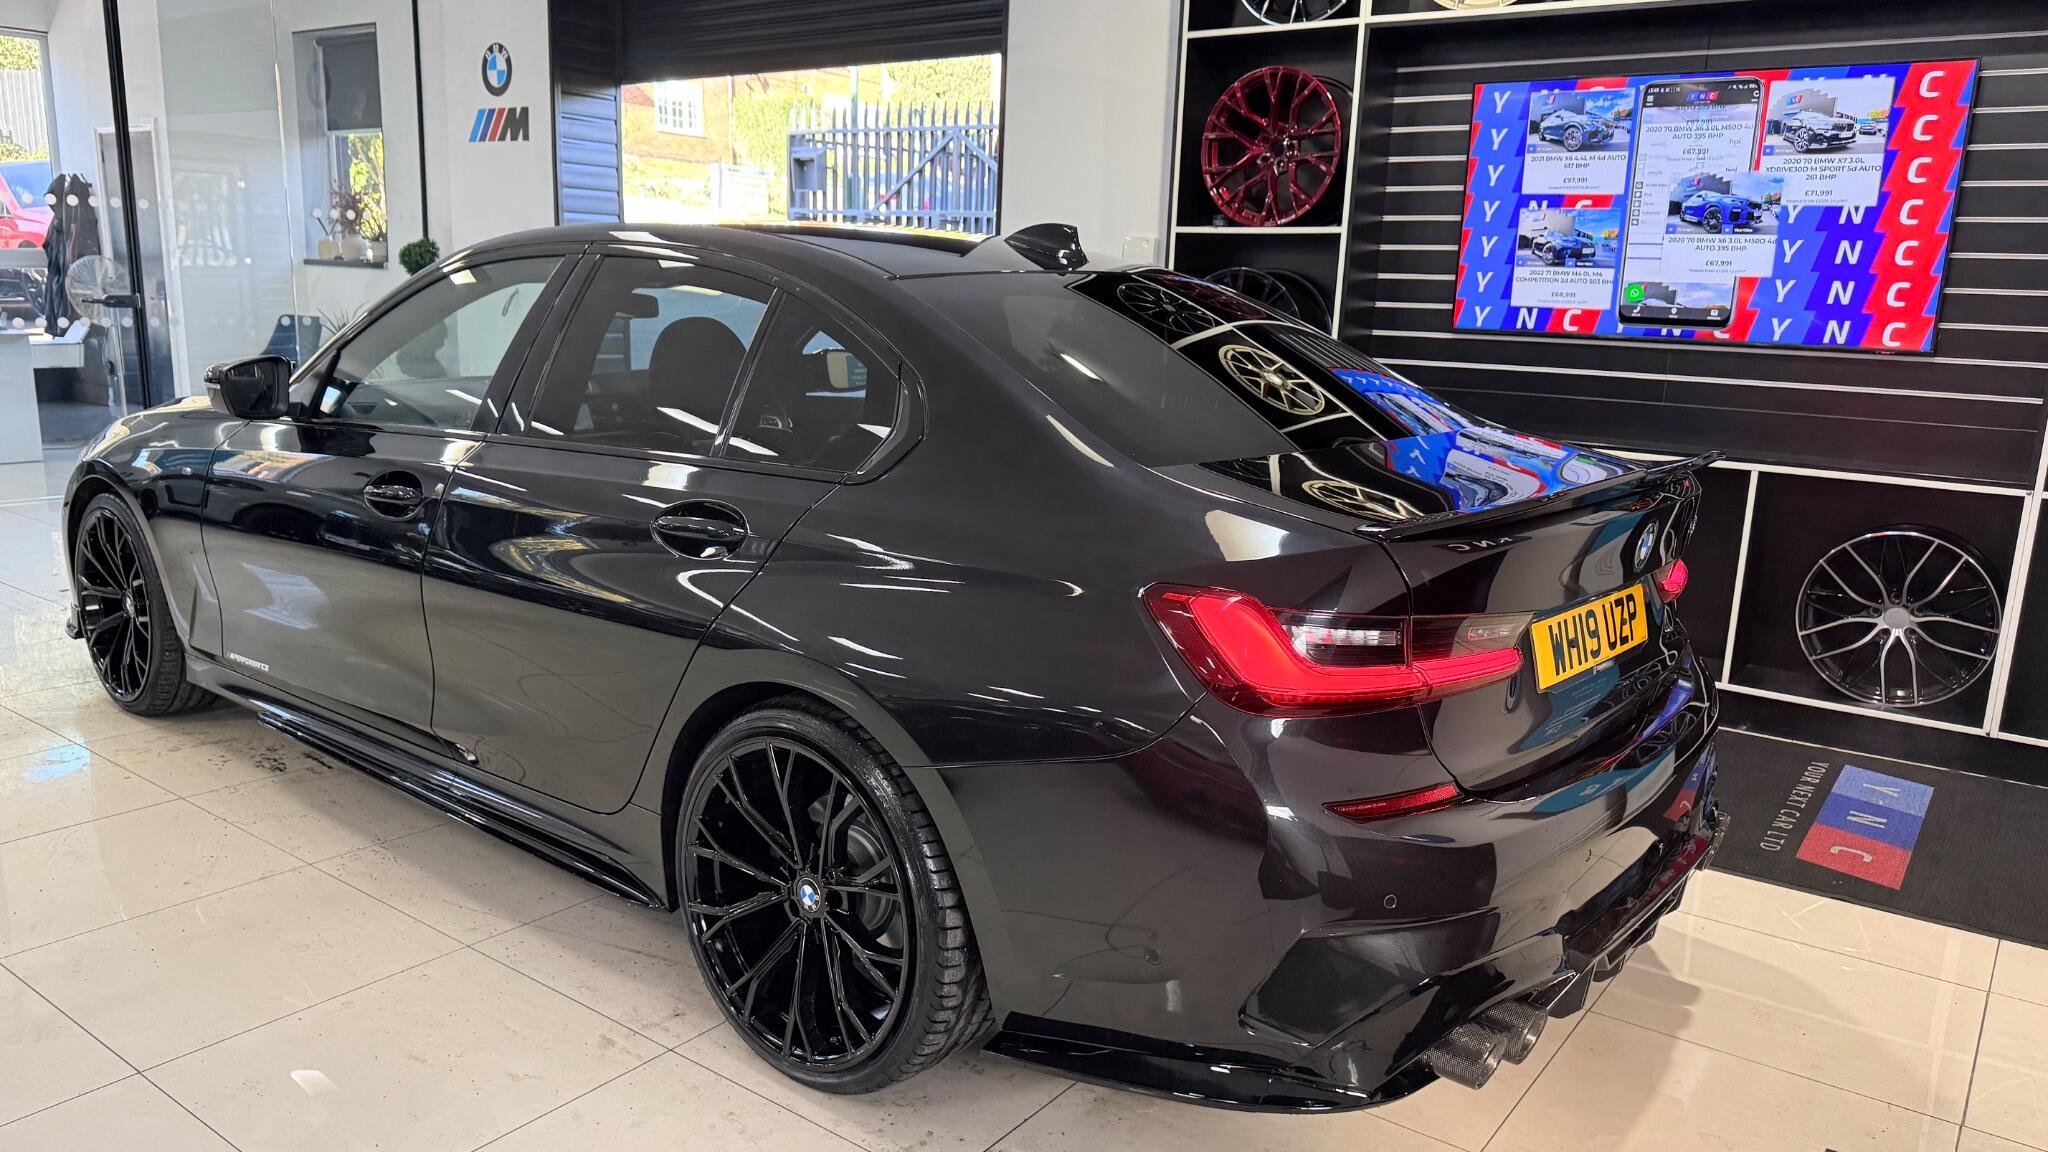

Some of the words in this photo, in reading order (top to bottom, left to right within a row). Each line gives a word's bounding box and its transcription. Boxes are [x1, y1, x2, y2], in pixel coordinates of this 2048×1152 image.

[1920, 70, 1946, 98] C
[1494, 90, 1512, 114] Y
[1490, 128, 1508, 151] Y
[1912, 114, 1938, 142] C
[1488, 164, 1505, 187] Y
[1908, 156, 1933, 184] C
[1484, 200, 1500, 223] Y
[1899, 199, 1923, 225] C
[1481, 235, 1499, 258] Y
[1783, 240, 1804, 263] Y
[1834, 240, 1863, 265] N
[1894, 240, 1919, 266] C
[1477, 271, 1494, 293] Y
[1775, 279, 1796, 303] Y
[1826, 281, 1855, 305] N
[1886, 282, 1911, 307] C
[1474, 306, 1492, 327] Y
[1516, 307, 1538, 329] N
[1563, 308, 1582, 332] C
[1771, 318, 1793, 341] Y
[1823, 320, 1851, 344] N
[1882, 322, 1907, 347] C
[1548, 608, 1601, 676] WH19
[1602, 592, 1637, 652] UZP
[1800, 761, 1830, 784] YOUR
[1786, 782, 1815, 809] NEXT
[1772, 808, 1800, 834] CAR
[1759, 830, 1788, 852] LTD
